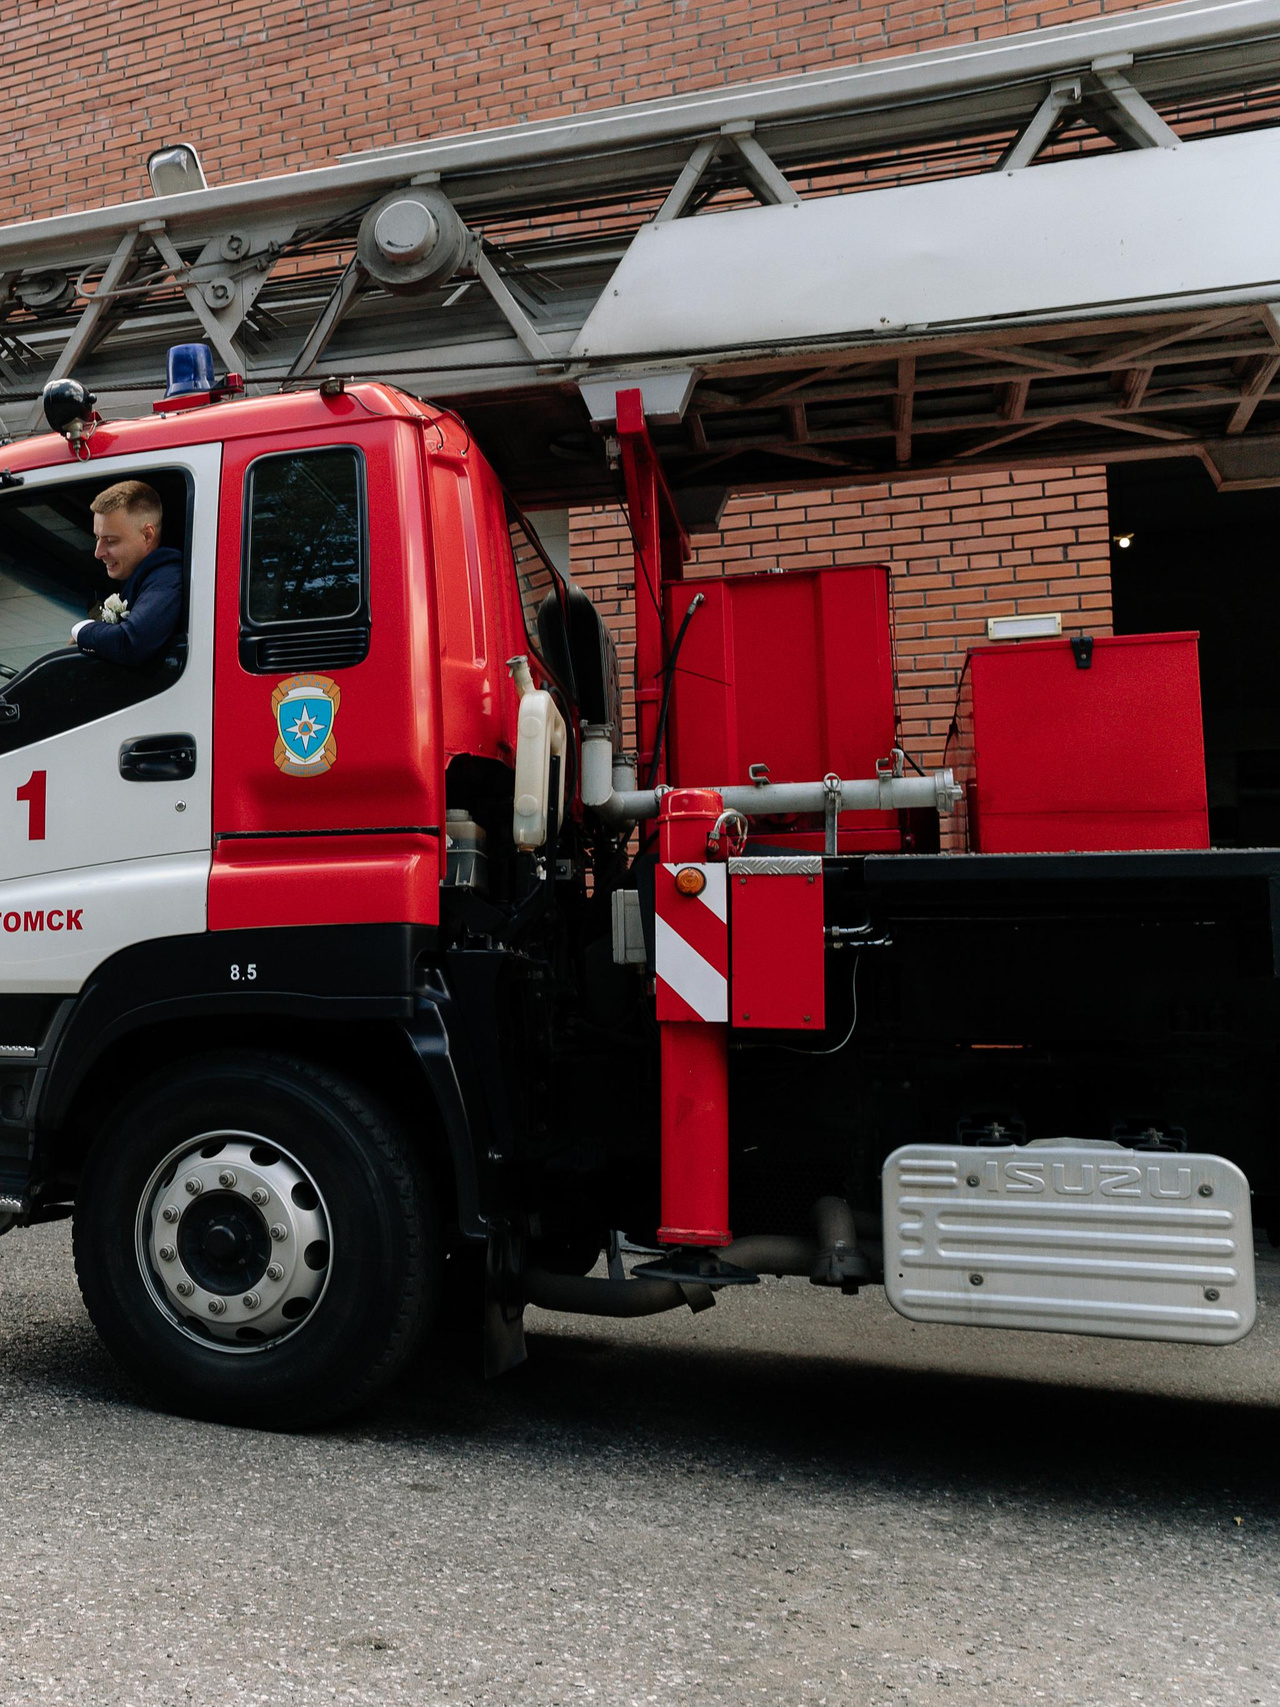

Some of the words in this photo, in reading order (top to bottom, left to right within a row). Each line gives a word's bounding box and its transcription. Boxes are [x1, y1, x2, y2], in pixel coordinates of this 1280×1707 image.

[16, 770, 47, 840] 1
[230, 963, 257, 981] 8.5
[986, 1161, 1191, 1199] ISUZU
